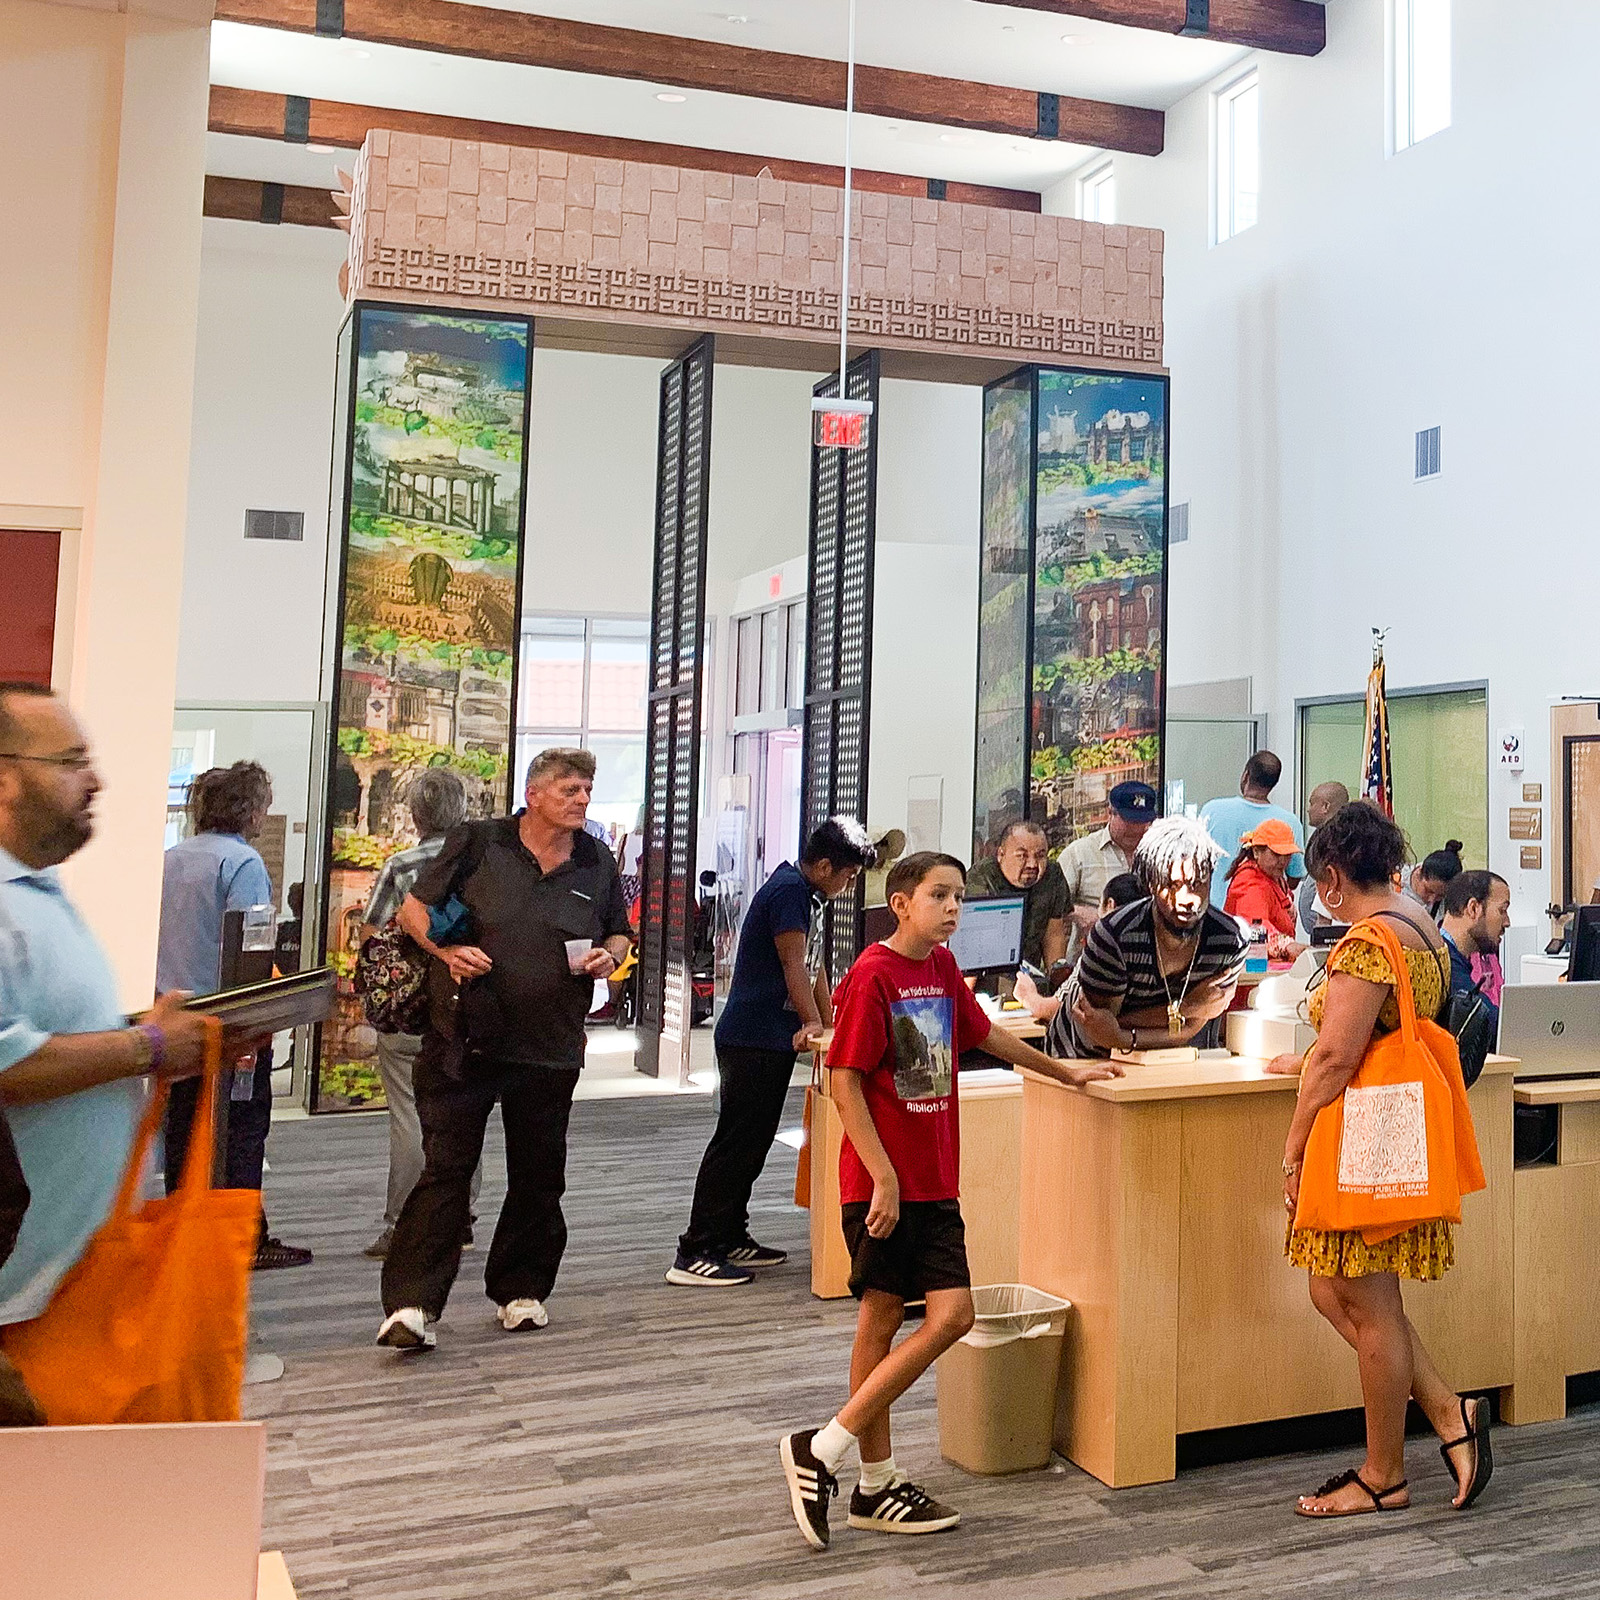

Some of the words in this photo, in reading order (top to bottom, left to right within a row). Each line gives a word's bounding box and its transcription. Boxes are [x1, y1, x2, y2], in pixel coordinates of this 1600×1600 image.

[1501, 755, 1520, 763] AED
[1375, 1184, 1399, 1193] PUBLIC
[1400, 1183, 1429, 1192] LIBRARY
